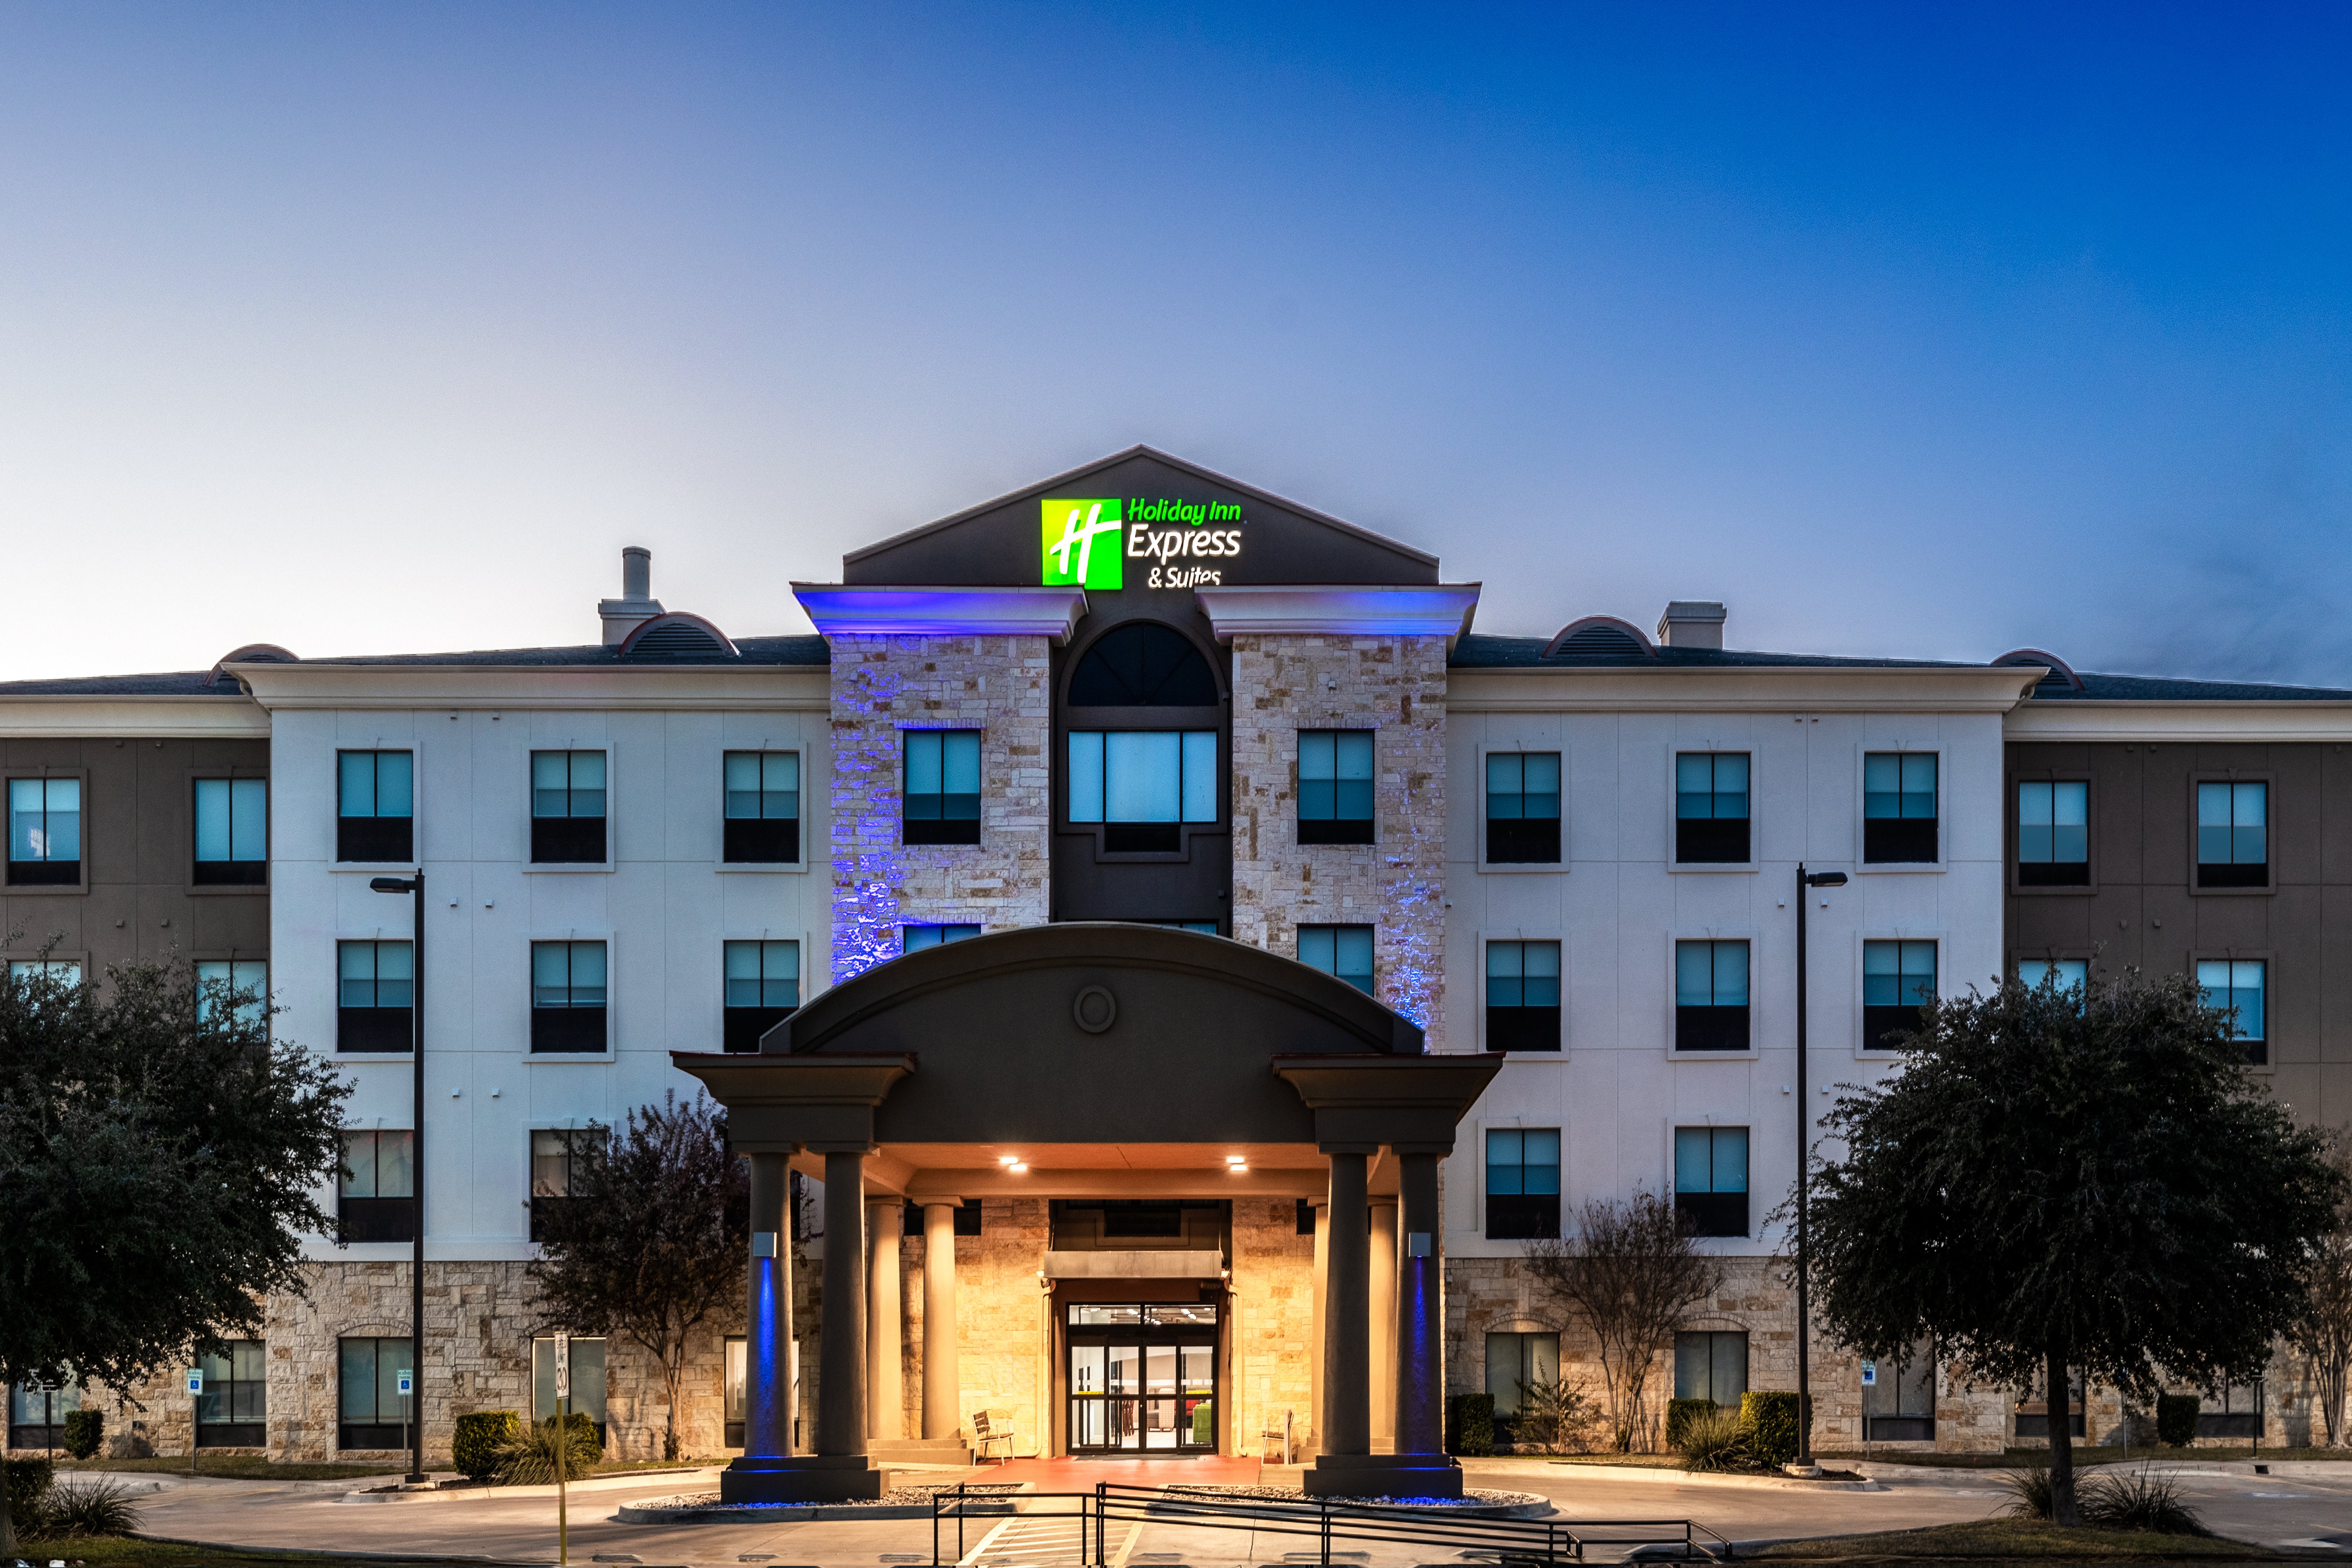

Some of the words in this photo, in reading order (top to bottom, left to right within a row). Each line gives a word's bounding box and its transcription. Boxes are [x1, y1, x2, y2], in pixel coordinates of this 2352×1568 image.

[1127, 498, 1206, 526] Holiday
[1209, 500, 1241, 521] Inn
[1127, 523, 1242, 566] Express
[1148, 566, 1163, 588] &
[1165, 566, 1222, 588] Suites
[557, 1367, 567, 1390] 30
